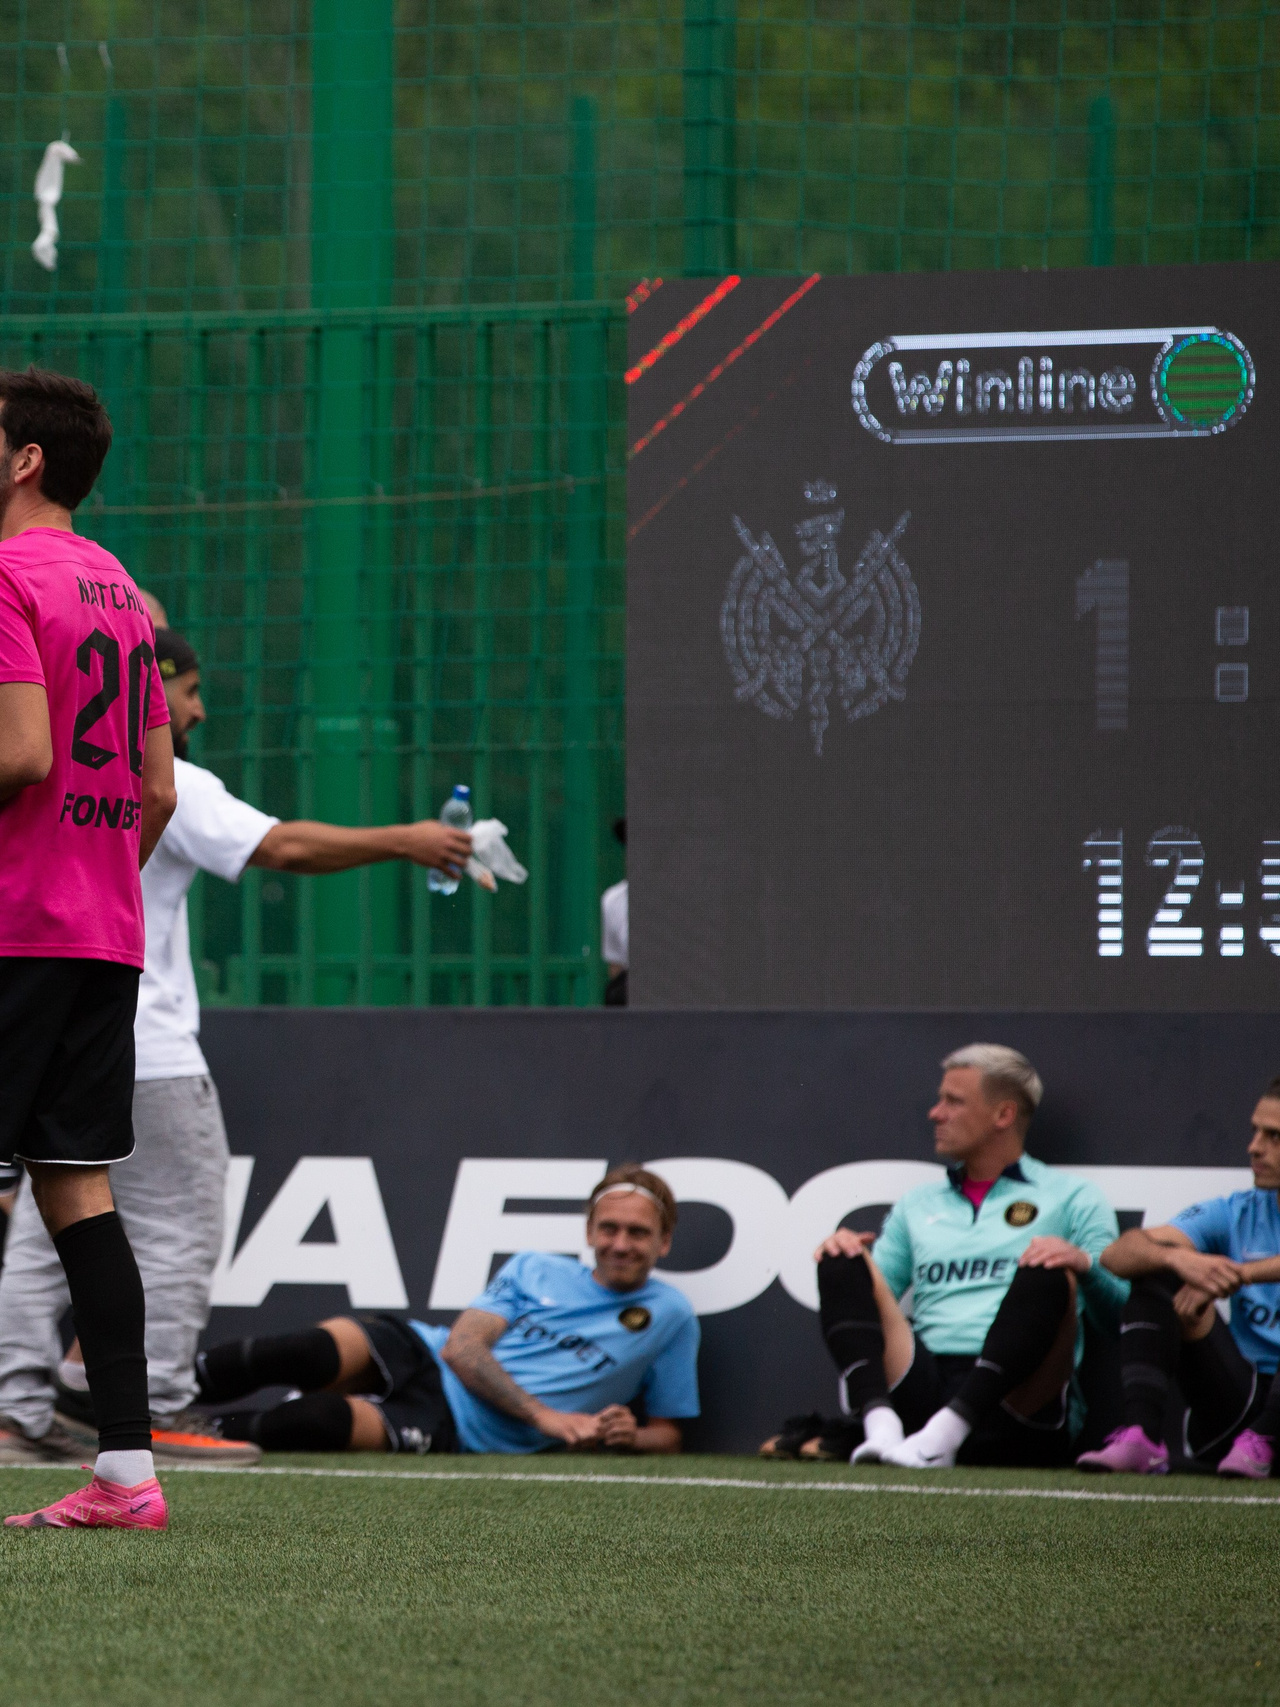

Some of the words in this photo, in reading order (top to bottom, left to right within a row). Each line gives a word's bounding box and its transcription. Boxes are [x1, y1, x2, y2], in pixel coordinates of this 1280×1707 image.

[888, 356, 1137, 414] Winline
[1076, 558, 1130, 731] 1
[72, 628, 155, 778] 20
[917, 1257, 1020, 1284] FONBE
